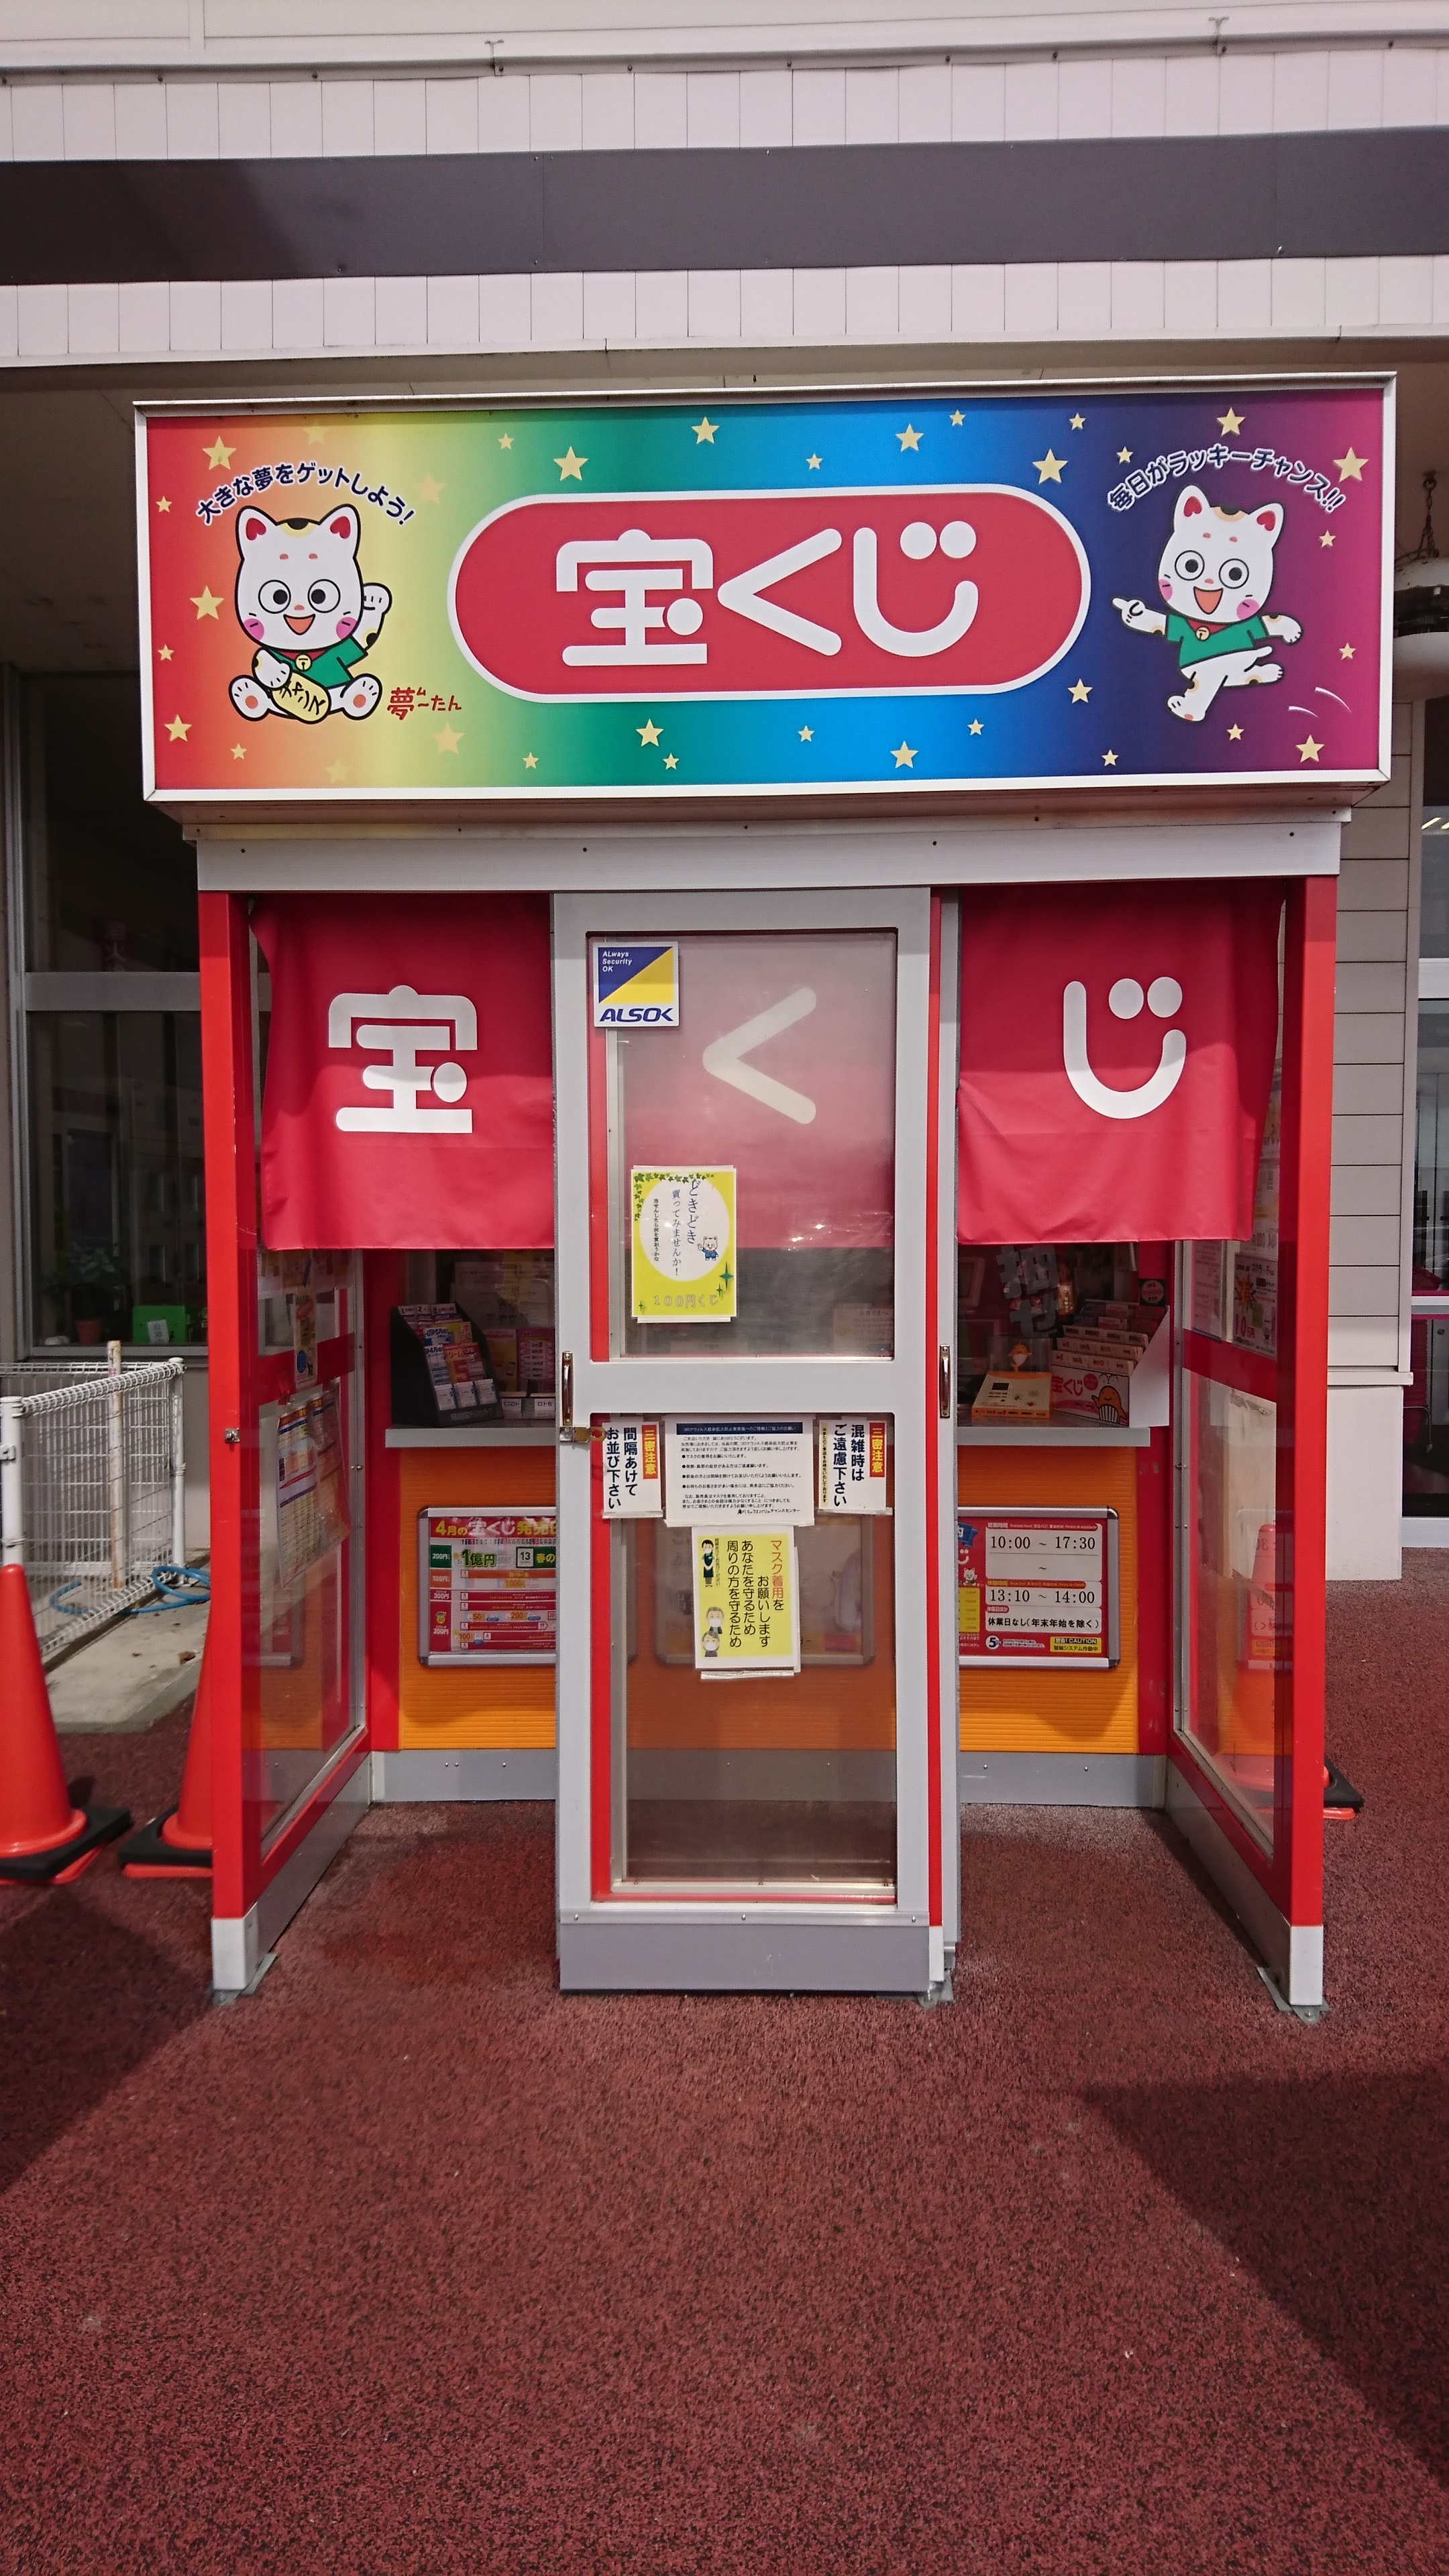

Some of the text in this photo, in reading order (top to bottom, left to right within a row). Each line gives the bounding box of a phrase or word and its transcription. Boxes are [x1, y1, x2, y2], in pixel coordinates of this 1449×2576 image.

[197, 462, 414, 524] 大きな夢をゲットしよう!
[1108, 443, 1346, 513] 毎日がラッキーチャンス!!
[556, 521, 978, 666] 宝くじ
[602, 951, 629, 959] ALways
[602, 958, 633, 966] Security
[599, 1008, 674, 1022] ALSOK
[329, 977, 1187, 1133] 宝 く じ
[672, 1189, 682, 1275] 買ってみませんか！
[688, 1180, 701, 1244] どきどき
[653, 1294, 718, 1307] 100円くじ
[606, 1427, 621, 1509] お並び下さい
[623, 1427, 638, 1496] 間隔あけて
[644, 1430, 657, 1474] 三密注意
[833, 1424, 847, 1507] ご遠慮下さい
[851, 1424, 865, 1481] 混雑時は
[871, 1428, 883, 1473] 三密注意
[462, 1548, 496, 1567] 1億円
[520, 1552, 531, 1560] 13
[991, 1536, 1031, 1549] 10:00
[1055, 1536, 1095, 1550] 17:30
[727, 1540, 742, 1648] 周りの方を守るため
[741, 1540, 756, 1635] あなたを守るため
[771, 1540, 784, 1611] マスク着用を
[990, 1589, 1030, 1602] 13:10
[1055, 1591, 1095, 1604] 14:00
[757, 1576, 771, 1648] お願いします
[987, 1617, 1099, 1629] 休業日なし(年末年始を除く)
